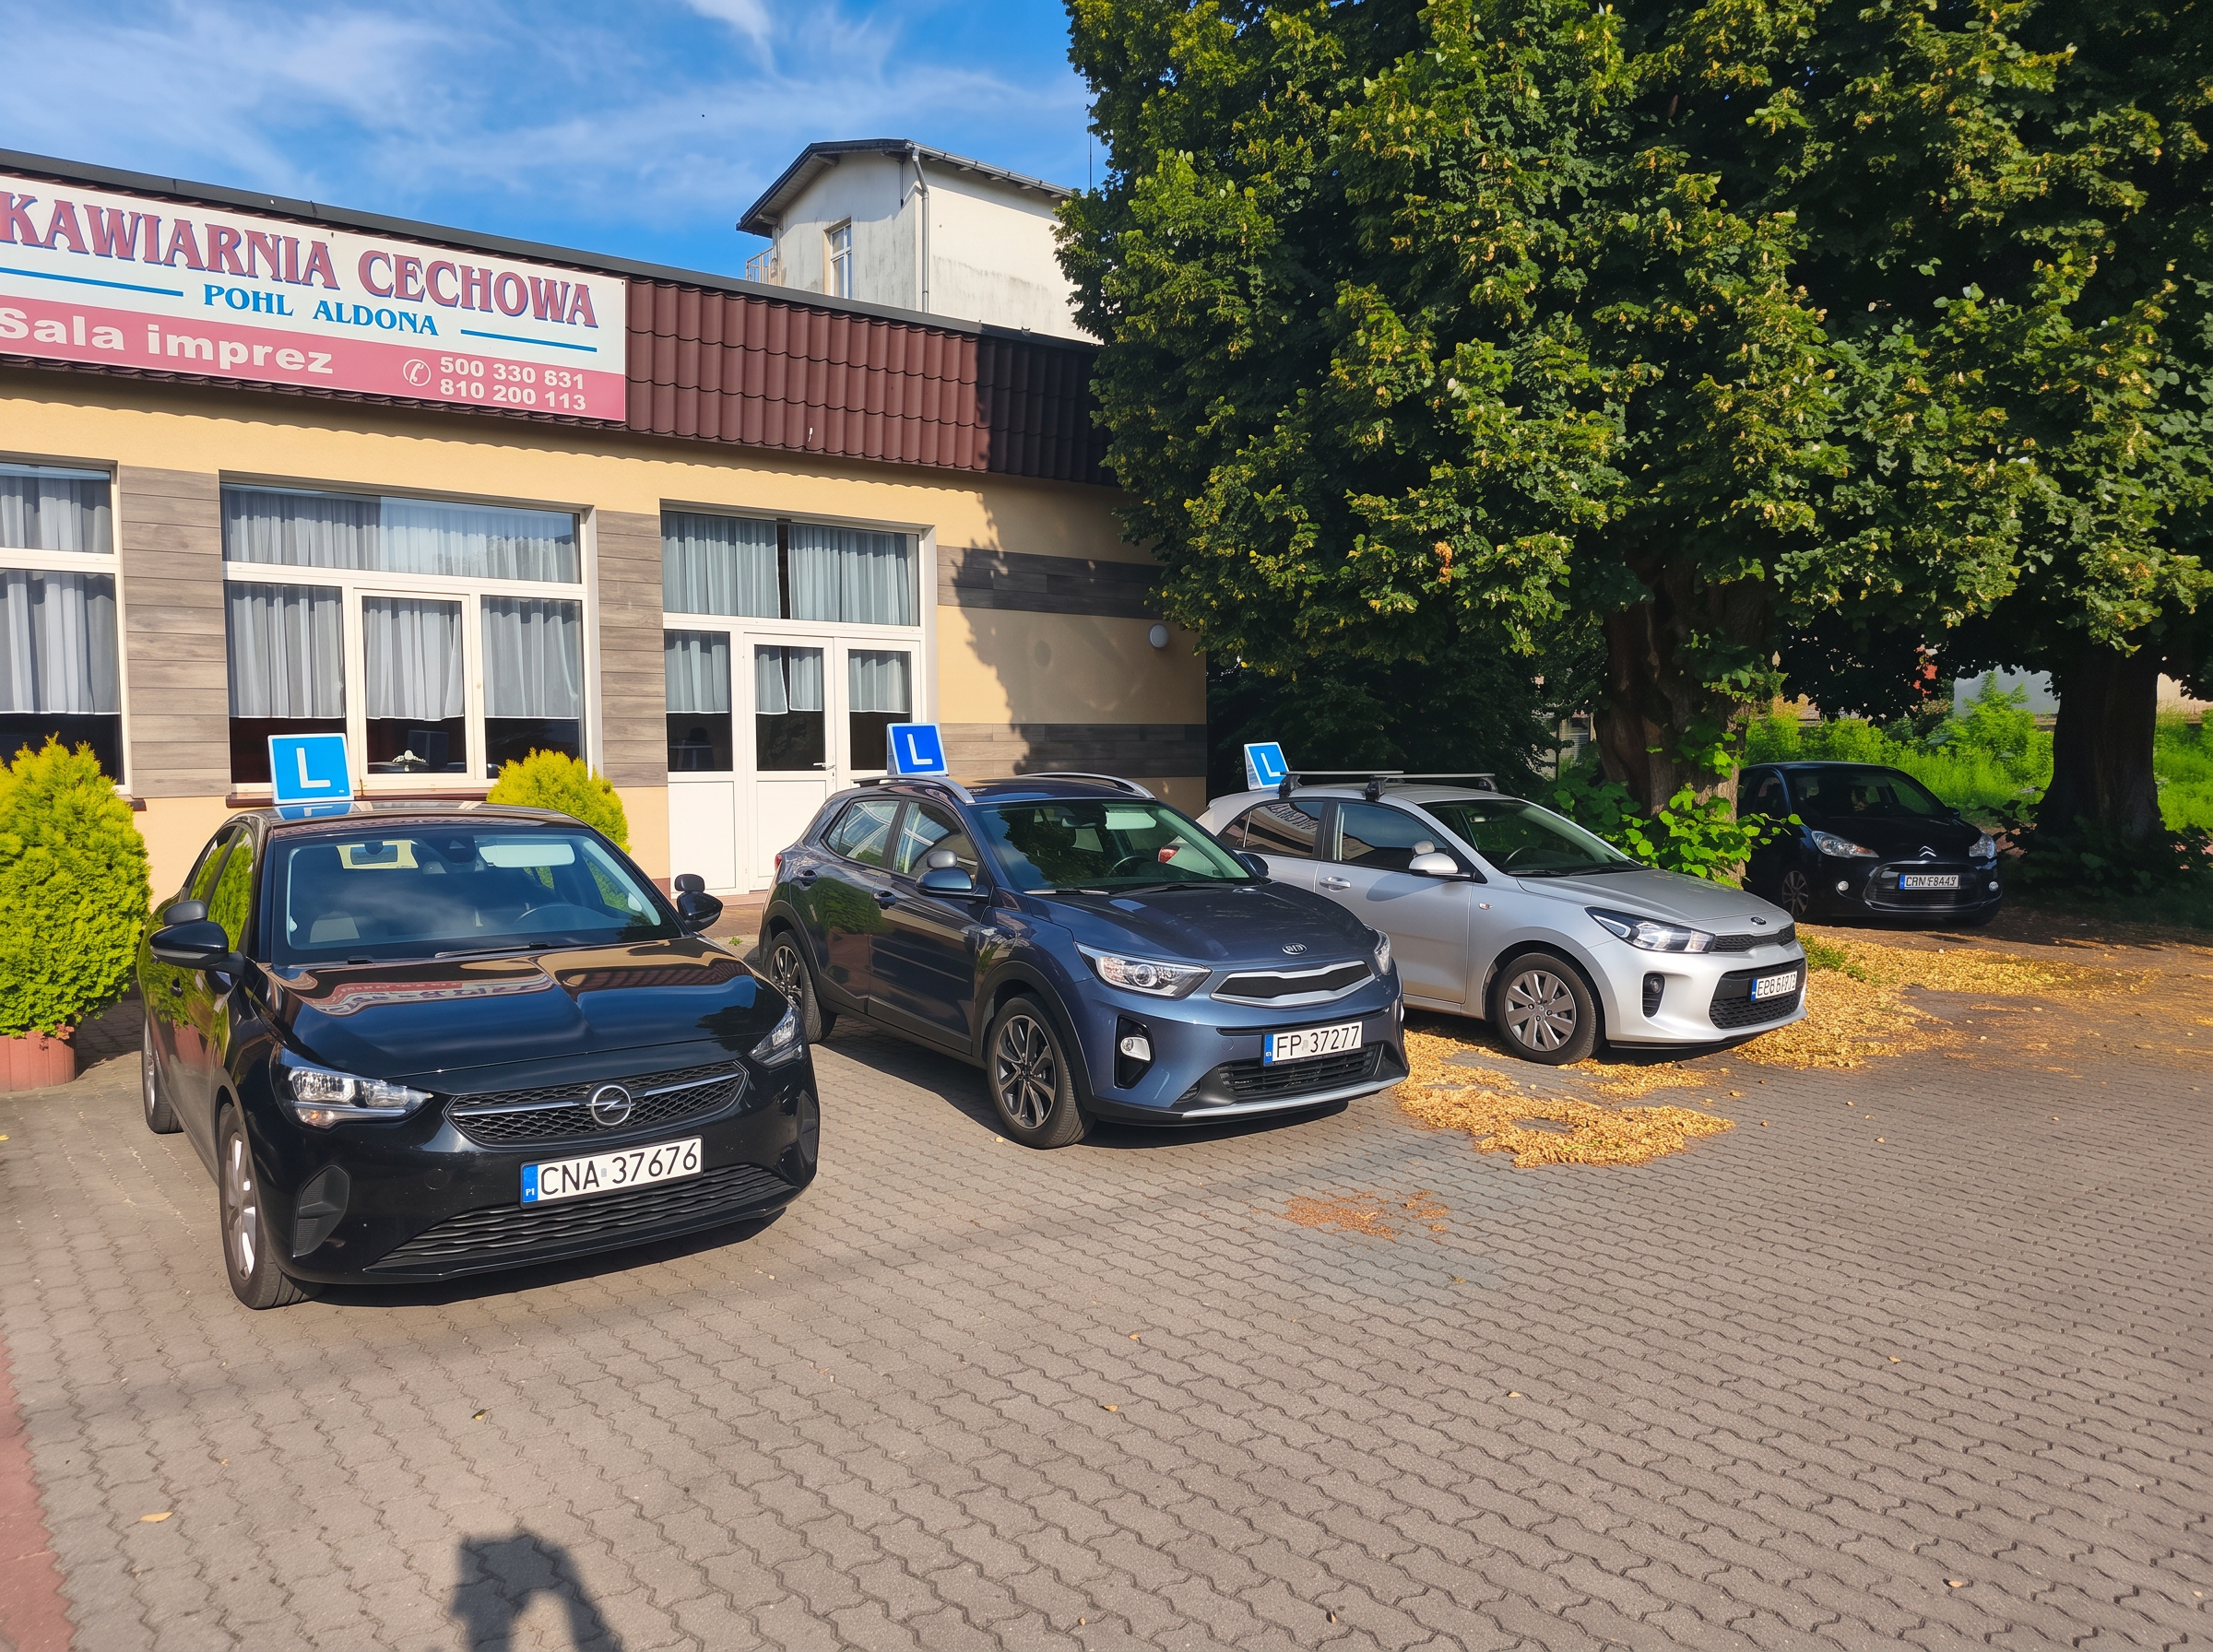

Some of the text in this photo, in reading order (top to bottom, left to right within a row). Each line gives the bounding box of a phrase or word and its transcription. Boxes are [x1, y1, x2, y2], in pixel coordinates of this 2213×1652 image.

[0, 190, 598, 328] KAWIARNIA CECHOWA
[203, 284, 439, 336] POHL ALDONA
[0, 307, 334, 374] Sala imprez
[440, 357, 484, 377] 500
[492, 363, 537, 384] 330
[440, 378, 586, 410] 810 200 113
[296, 747, 331, 788] L
[906, 733, 933, 766] L
[1260, 752, 1281, 778] L
[1277, 1025, 1360, 1058] FP 37277
[540, 1141, 698, 1196] CNA 37676
